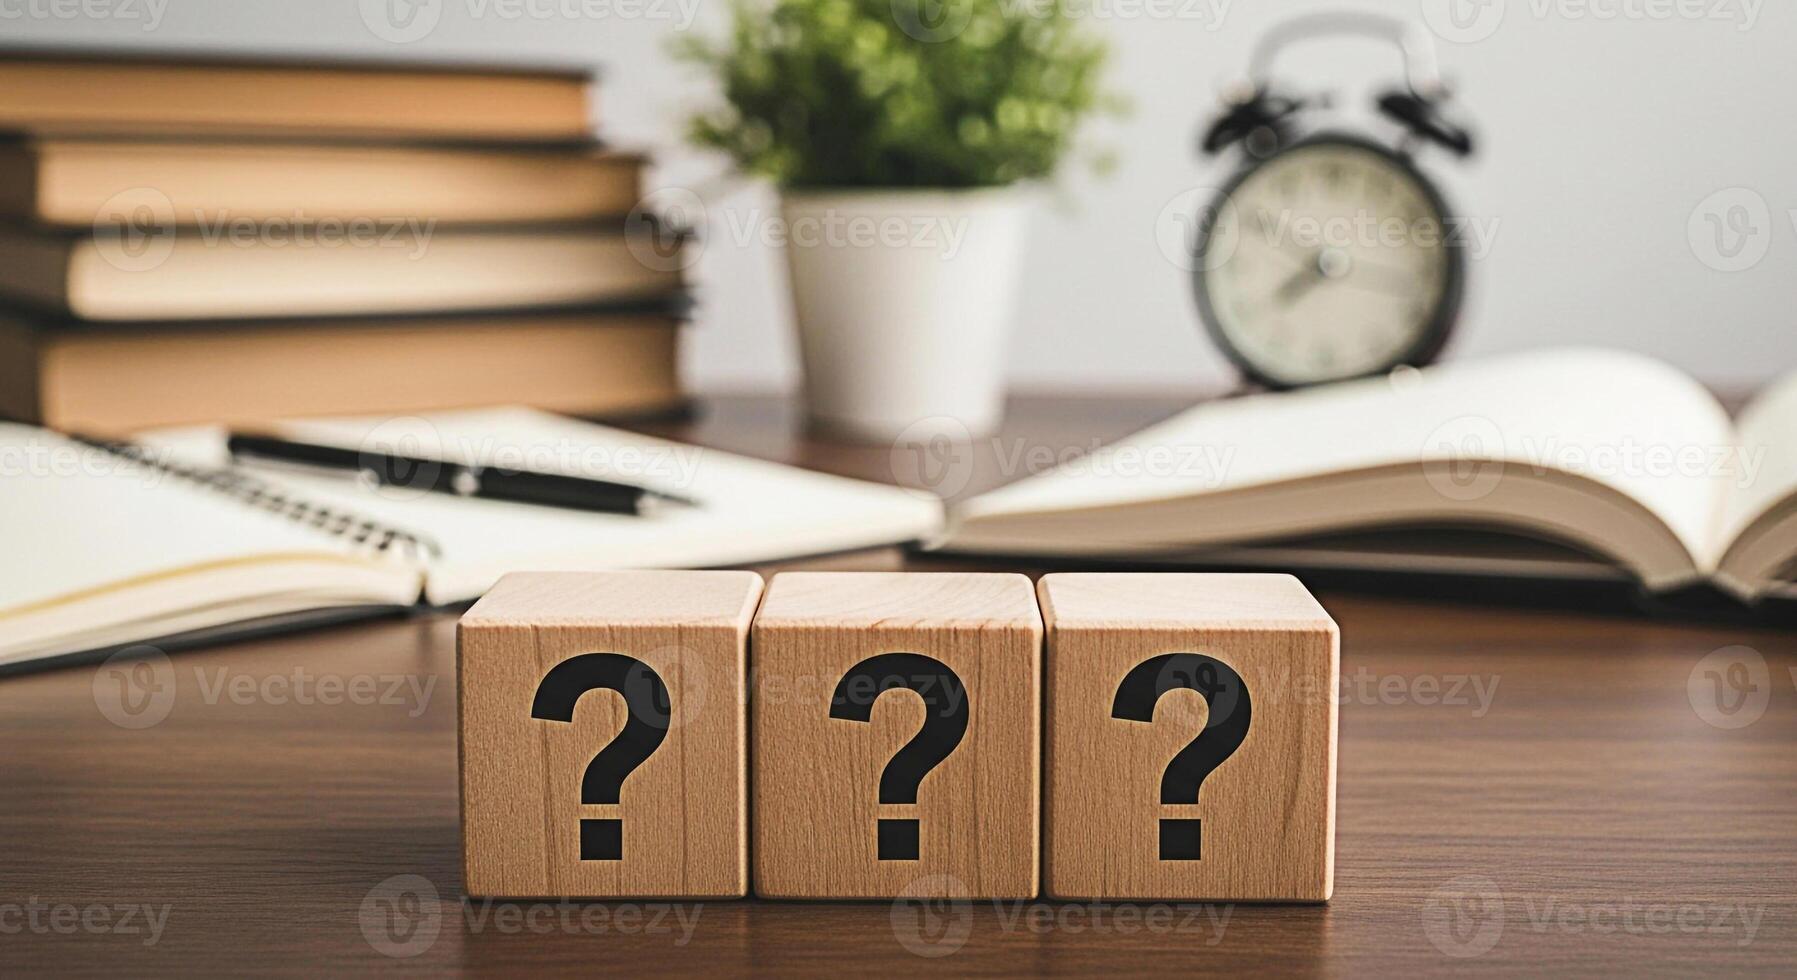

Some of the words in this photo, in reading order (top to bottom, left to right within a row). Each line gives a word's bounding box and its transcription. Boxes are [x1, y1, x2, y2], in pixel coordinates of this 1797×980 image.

[530, 652, 672, 861] ?
[828, 652, 970, 861] ?
[1111, 652, 1252, 861] ?
